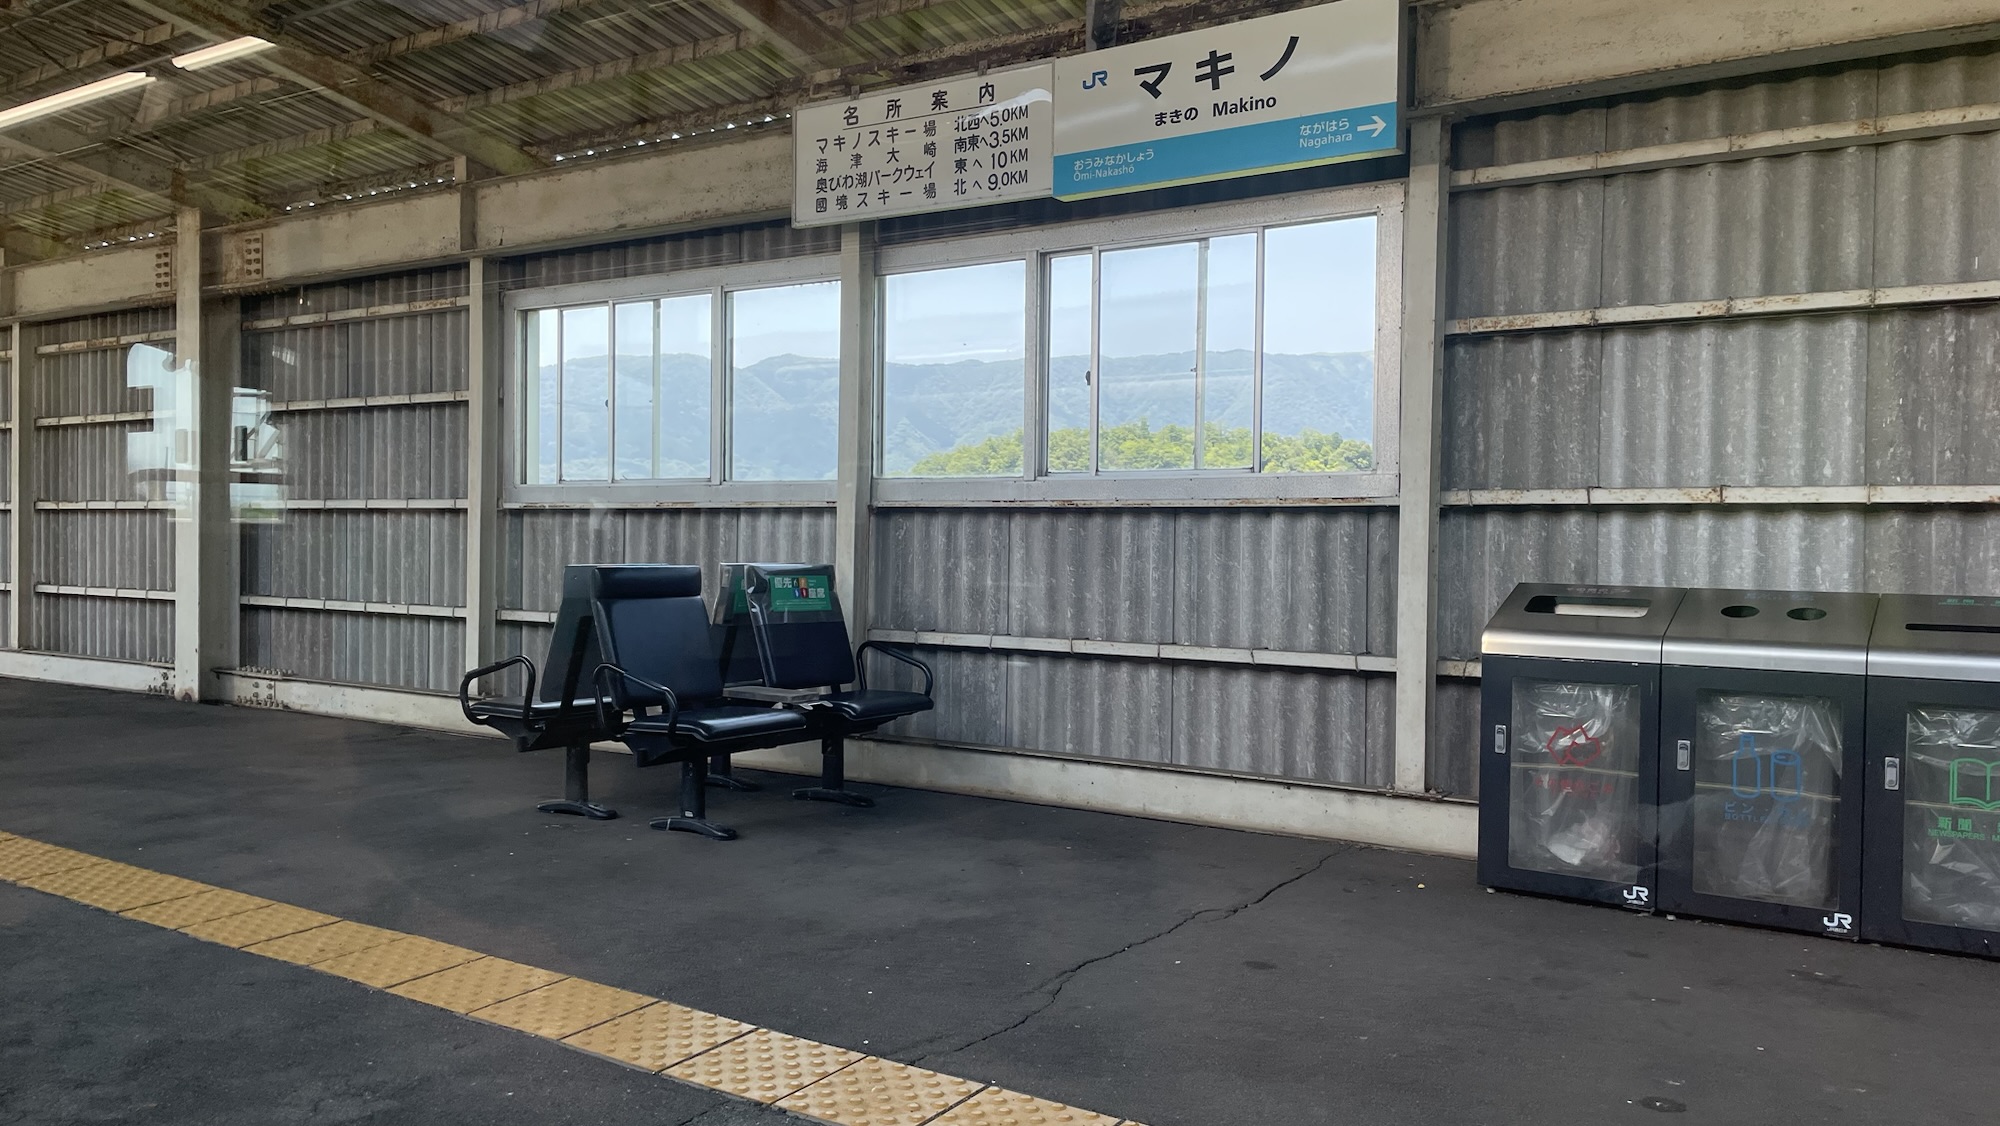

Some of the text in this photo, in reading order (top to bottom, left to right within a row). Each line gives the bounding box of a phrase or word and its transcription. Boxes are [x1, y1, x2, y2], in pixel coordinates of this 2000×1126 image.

[1134, 36, 1300, 99] マキノ
[1082, 70, 1108, 90] JR
[843, 82, 995, 126] 名所案内
[1212, 95, 1277, 118] Makino
[1154, 107, 1199, 127] まきの
[1299, 118, 1350, 137] ながはら
[816, 120, 937, 153] マキノスキー場
[1299, 132, 1353, 149] Nagahara
[816, 141, 937, 174] 海津大崎
[1073, 148, 1155, 171] おうみなかしょう
[1623, 885, 1649, 902] JR
[1823, 912, 1852, 930] JR
